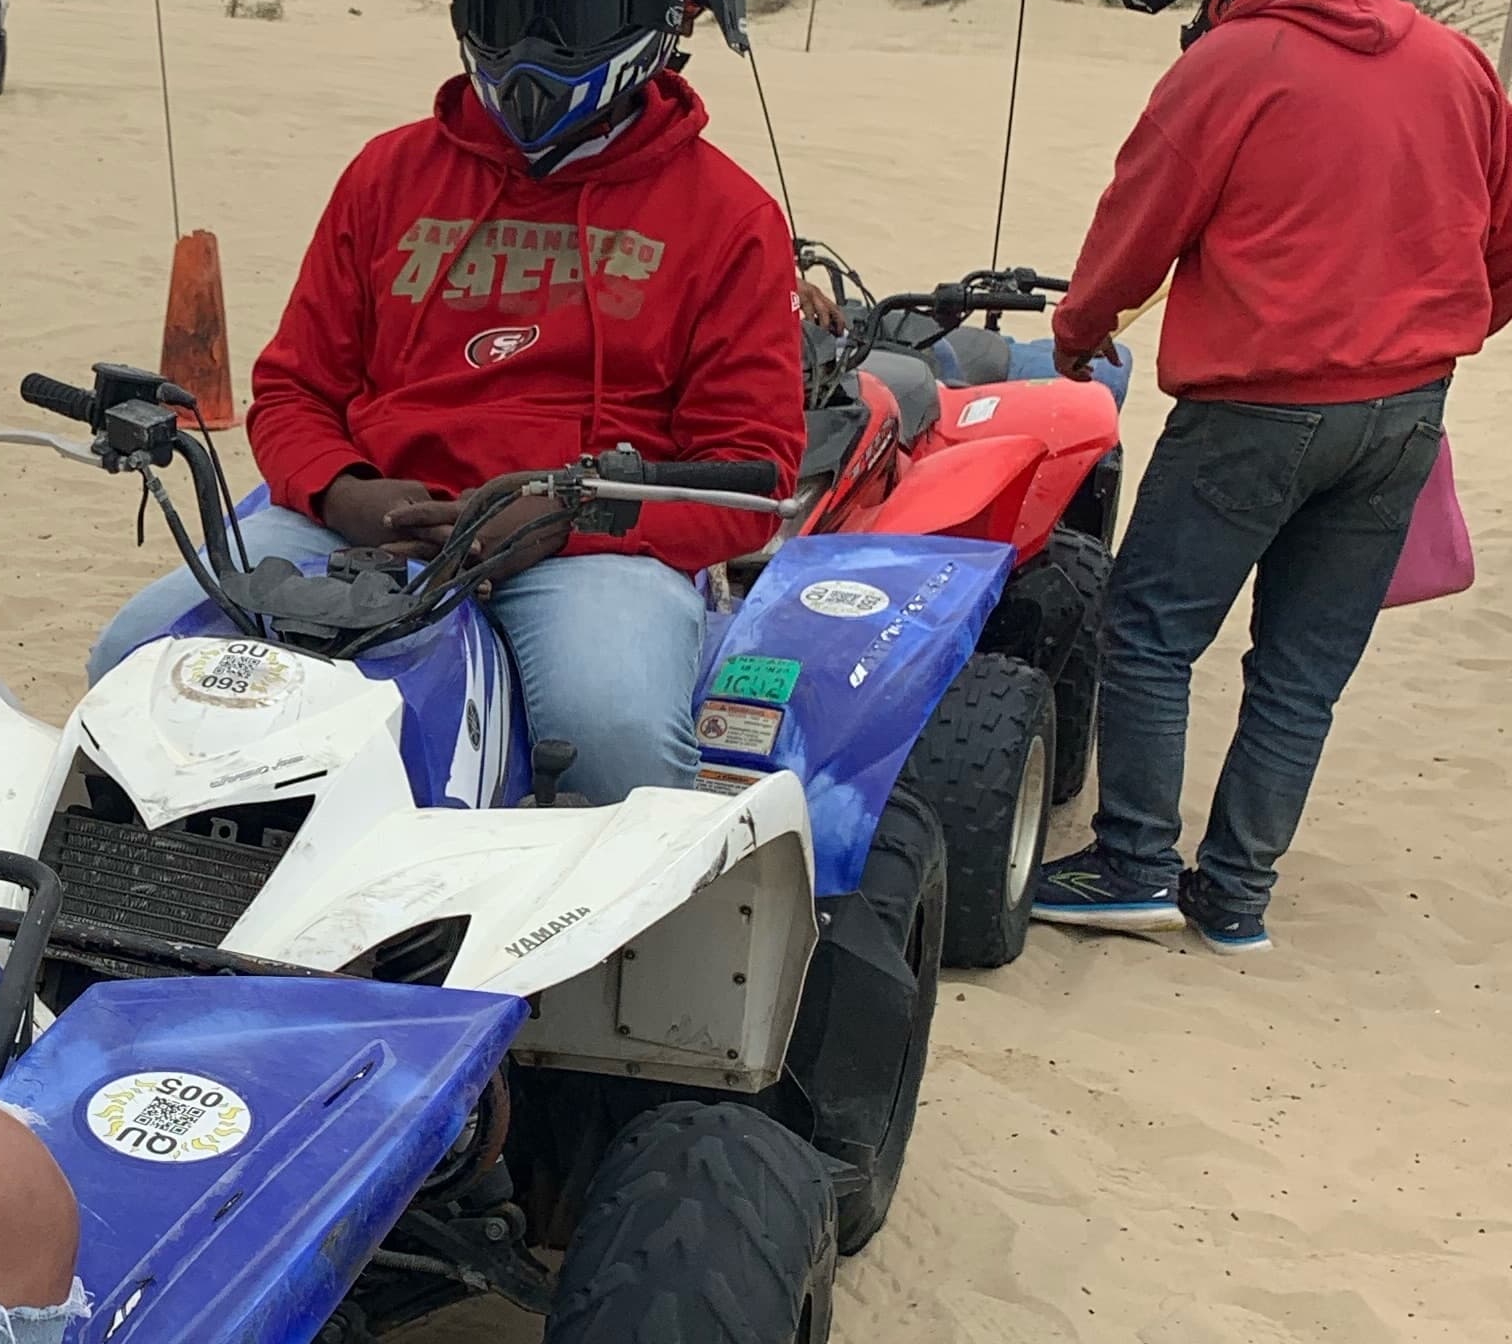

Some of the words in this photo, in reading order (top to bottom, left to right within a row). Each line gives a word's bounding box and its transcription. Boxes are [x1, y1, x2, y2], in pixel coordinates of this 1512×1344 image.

[228, 643, 270, 657] QU
[201, 675, 249, 694] 093
[504, 906, 591, 958] YAMAHA
[156, 1077, 224, 1108] 005
[115, 1126, 178, 1156] QU
